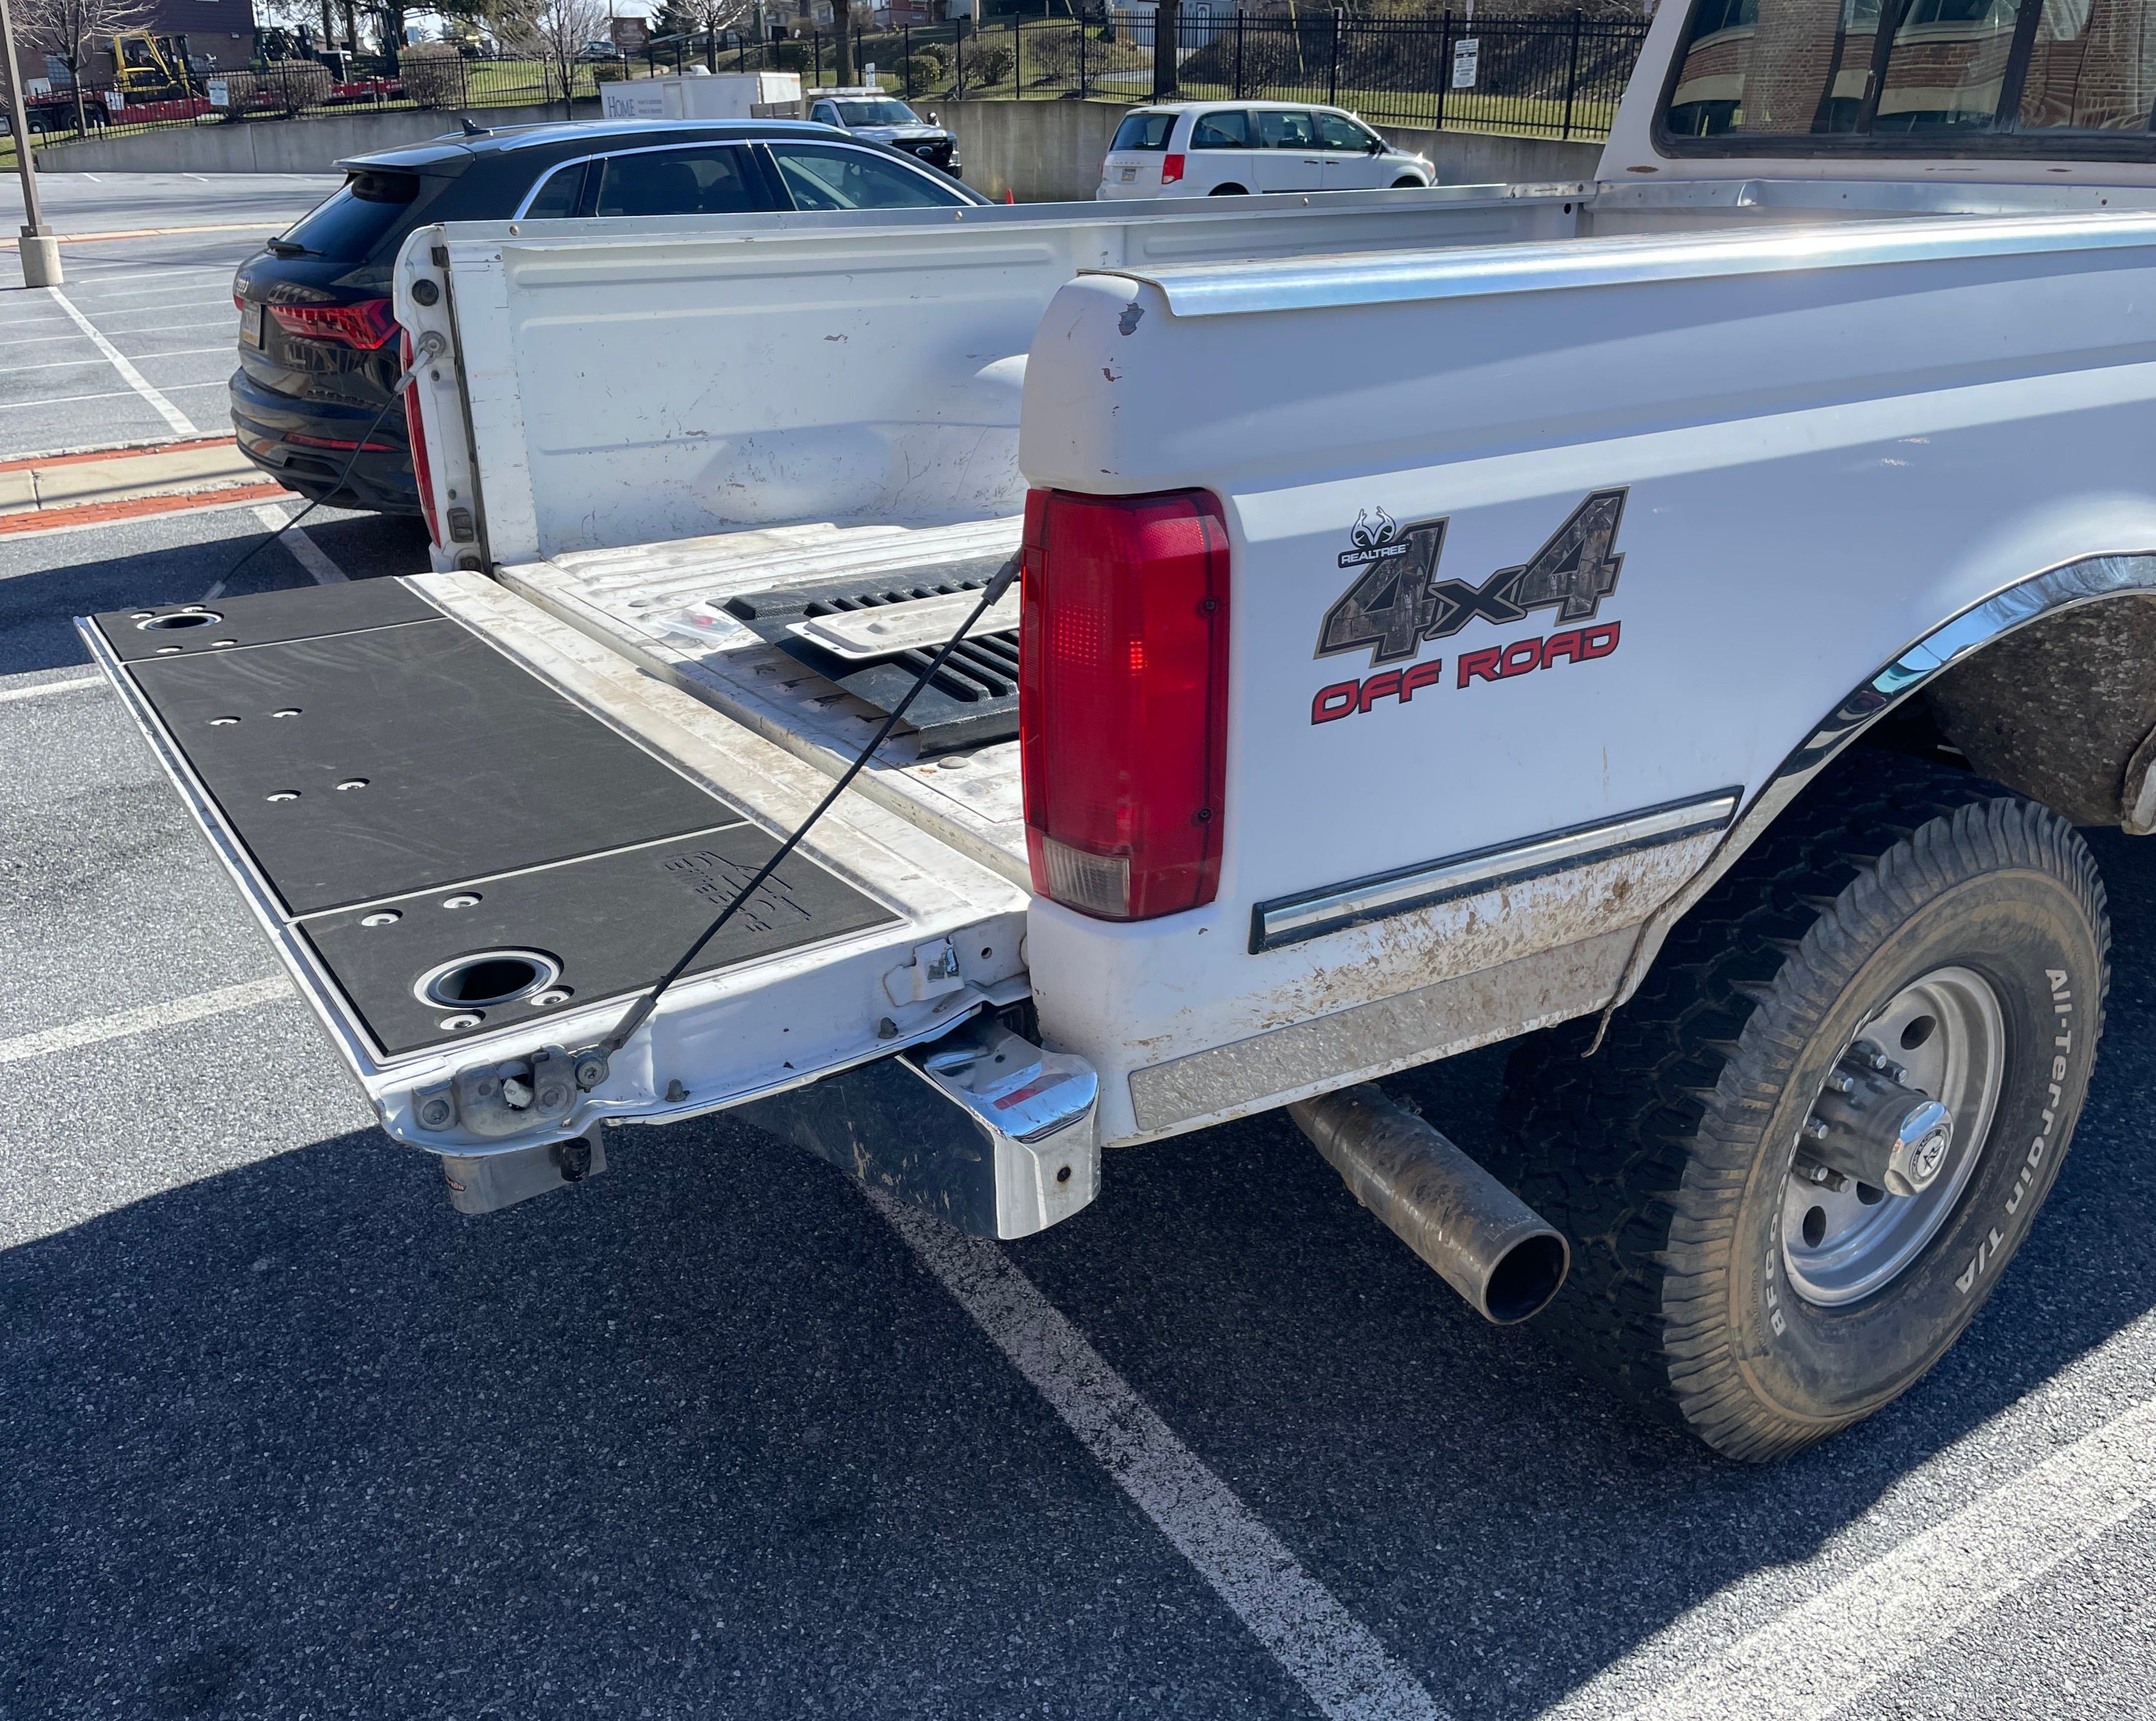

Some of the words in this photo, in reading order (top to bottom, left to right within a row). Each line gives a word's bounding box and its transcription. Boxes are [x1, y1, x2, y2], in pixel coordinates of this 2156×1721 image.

[607, 97, 635, 117] HOME
[1341, 544, 1407, 564] REALTREE
[1311, 659, 1442, 725] OFF
[1457, 621, 1621, 689] ROAD
[2005, 969, 2071, 1215] All-Terrain
